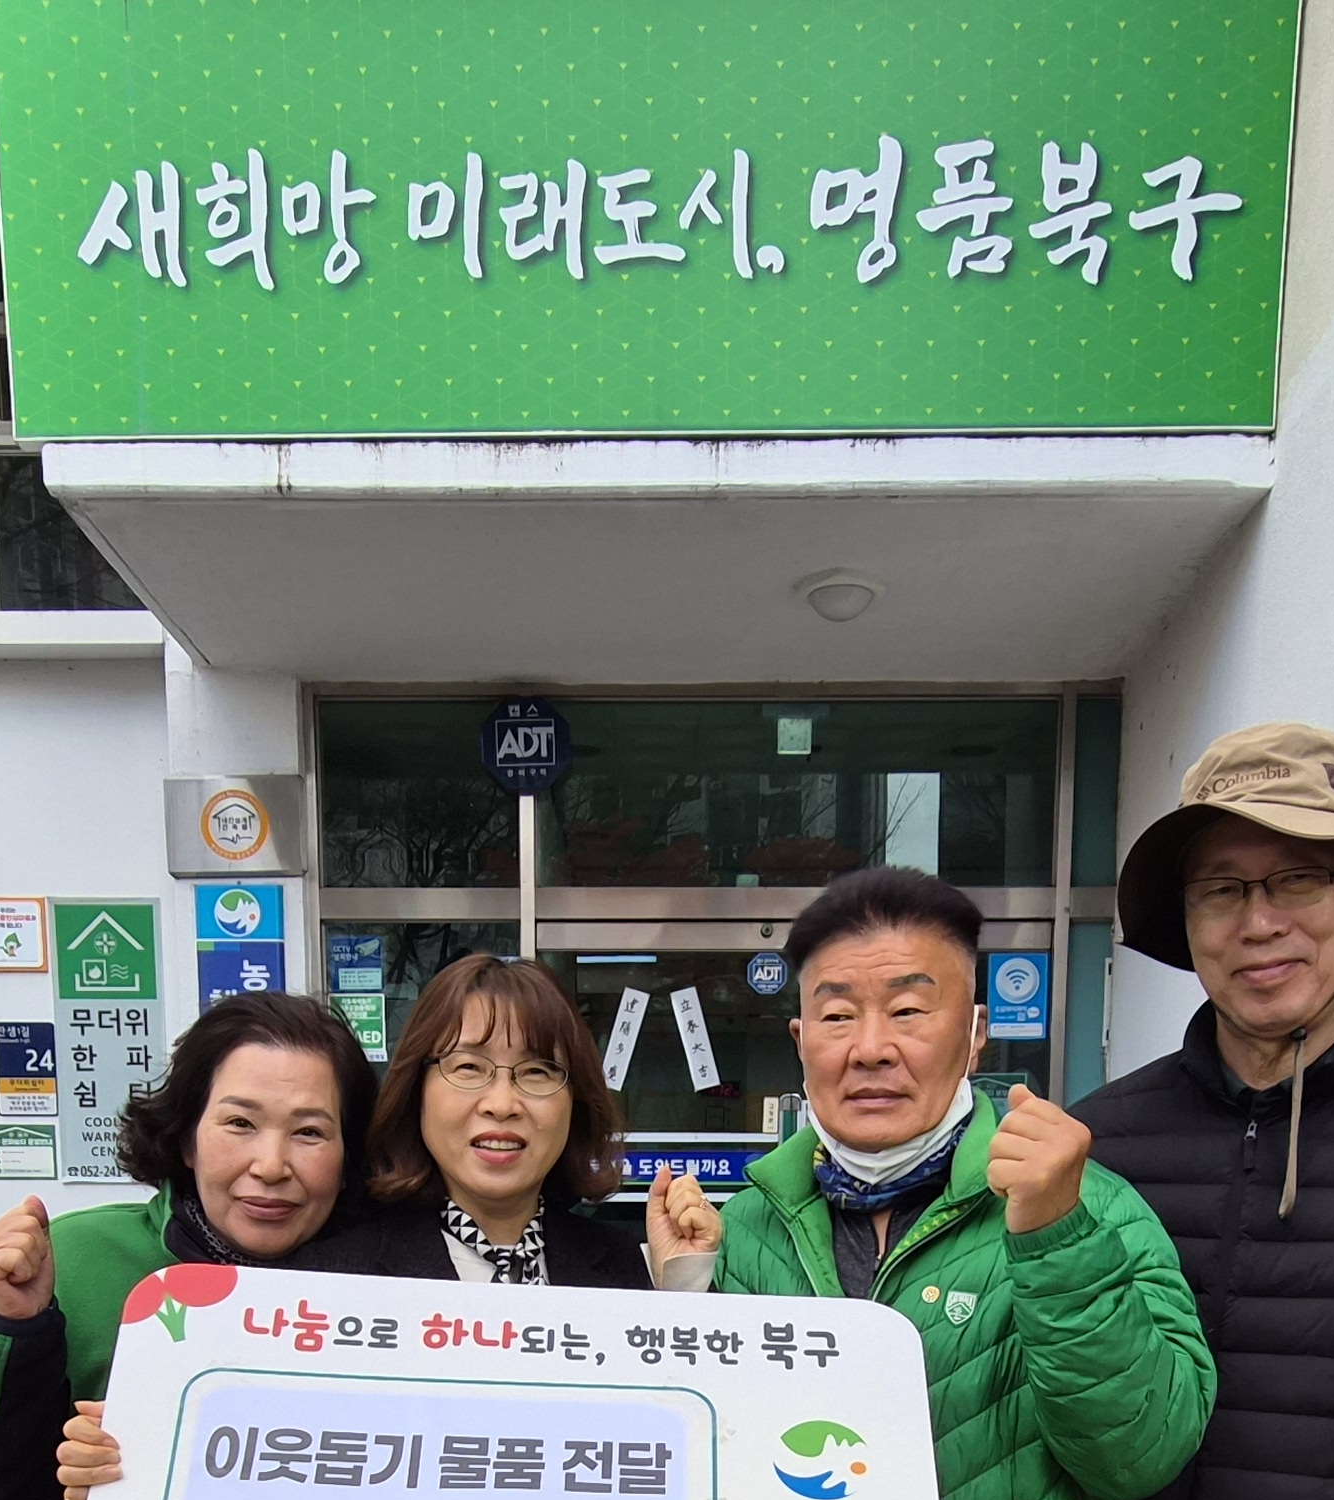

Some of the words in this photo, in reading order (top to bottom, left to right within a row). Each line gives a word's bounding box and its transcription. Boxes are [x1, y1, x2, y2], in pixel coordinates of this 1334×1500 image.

[76, 144, 376, 292] 새희망
[405, 148, 785, 282] 미래도시,
[809, 132, 1243, 286] 명품북구
[497, 726, 554, 759] ADT
[332, 945, 351, 953] CCTV
[753, 966, 781, 981] ADT
[69, 1008, 150, 1037] 무더위
[25, 1048, 55, 1072] 24
[71, 1044, 98, 1073] 한
[126, 1045, 153, 1073] 파
[73, 1080, 98, 1109] 쉼
[241, 1297, 399, 1353] 나눔으로
[421, 1312, 606, 1365] 하나되는,
[624, 1324, 743, 1366] 행복한
[760, 1320, 839, 1370] 북구
[203, 1424, 424, 1490] 이웃돕기
[438, 1434, 546, 1490] 물품
[561, 1440, 671, 1497] 전달
